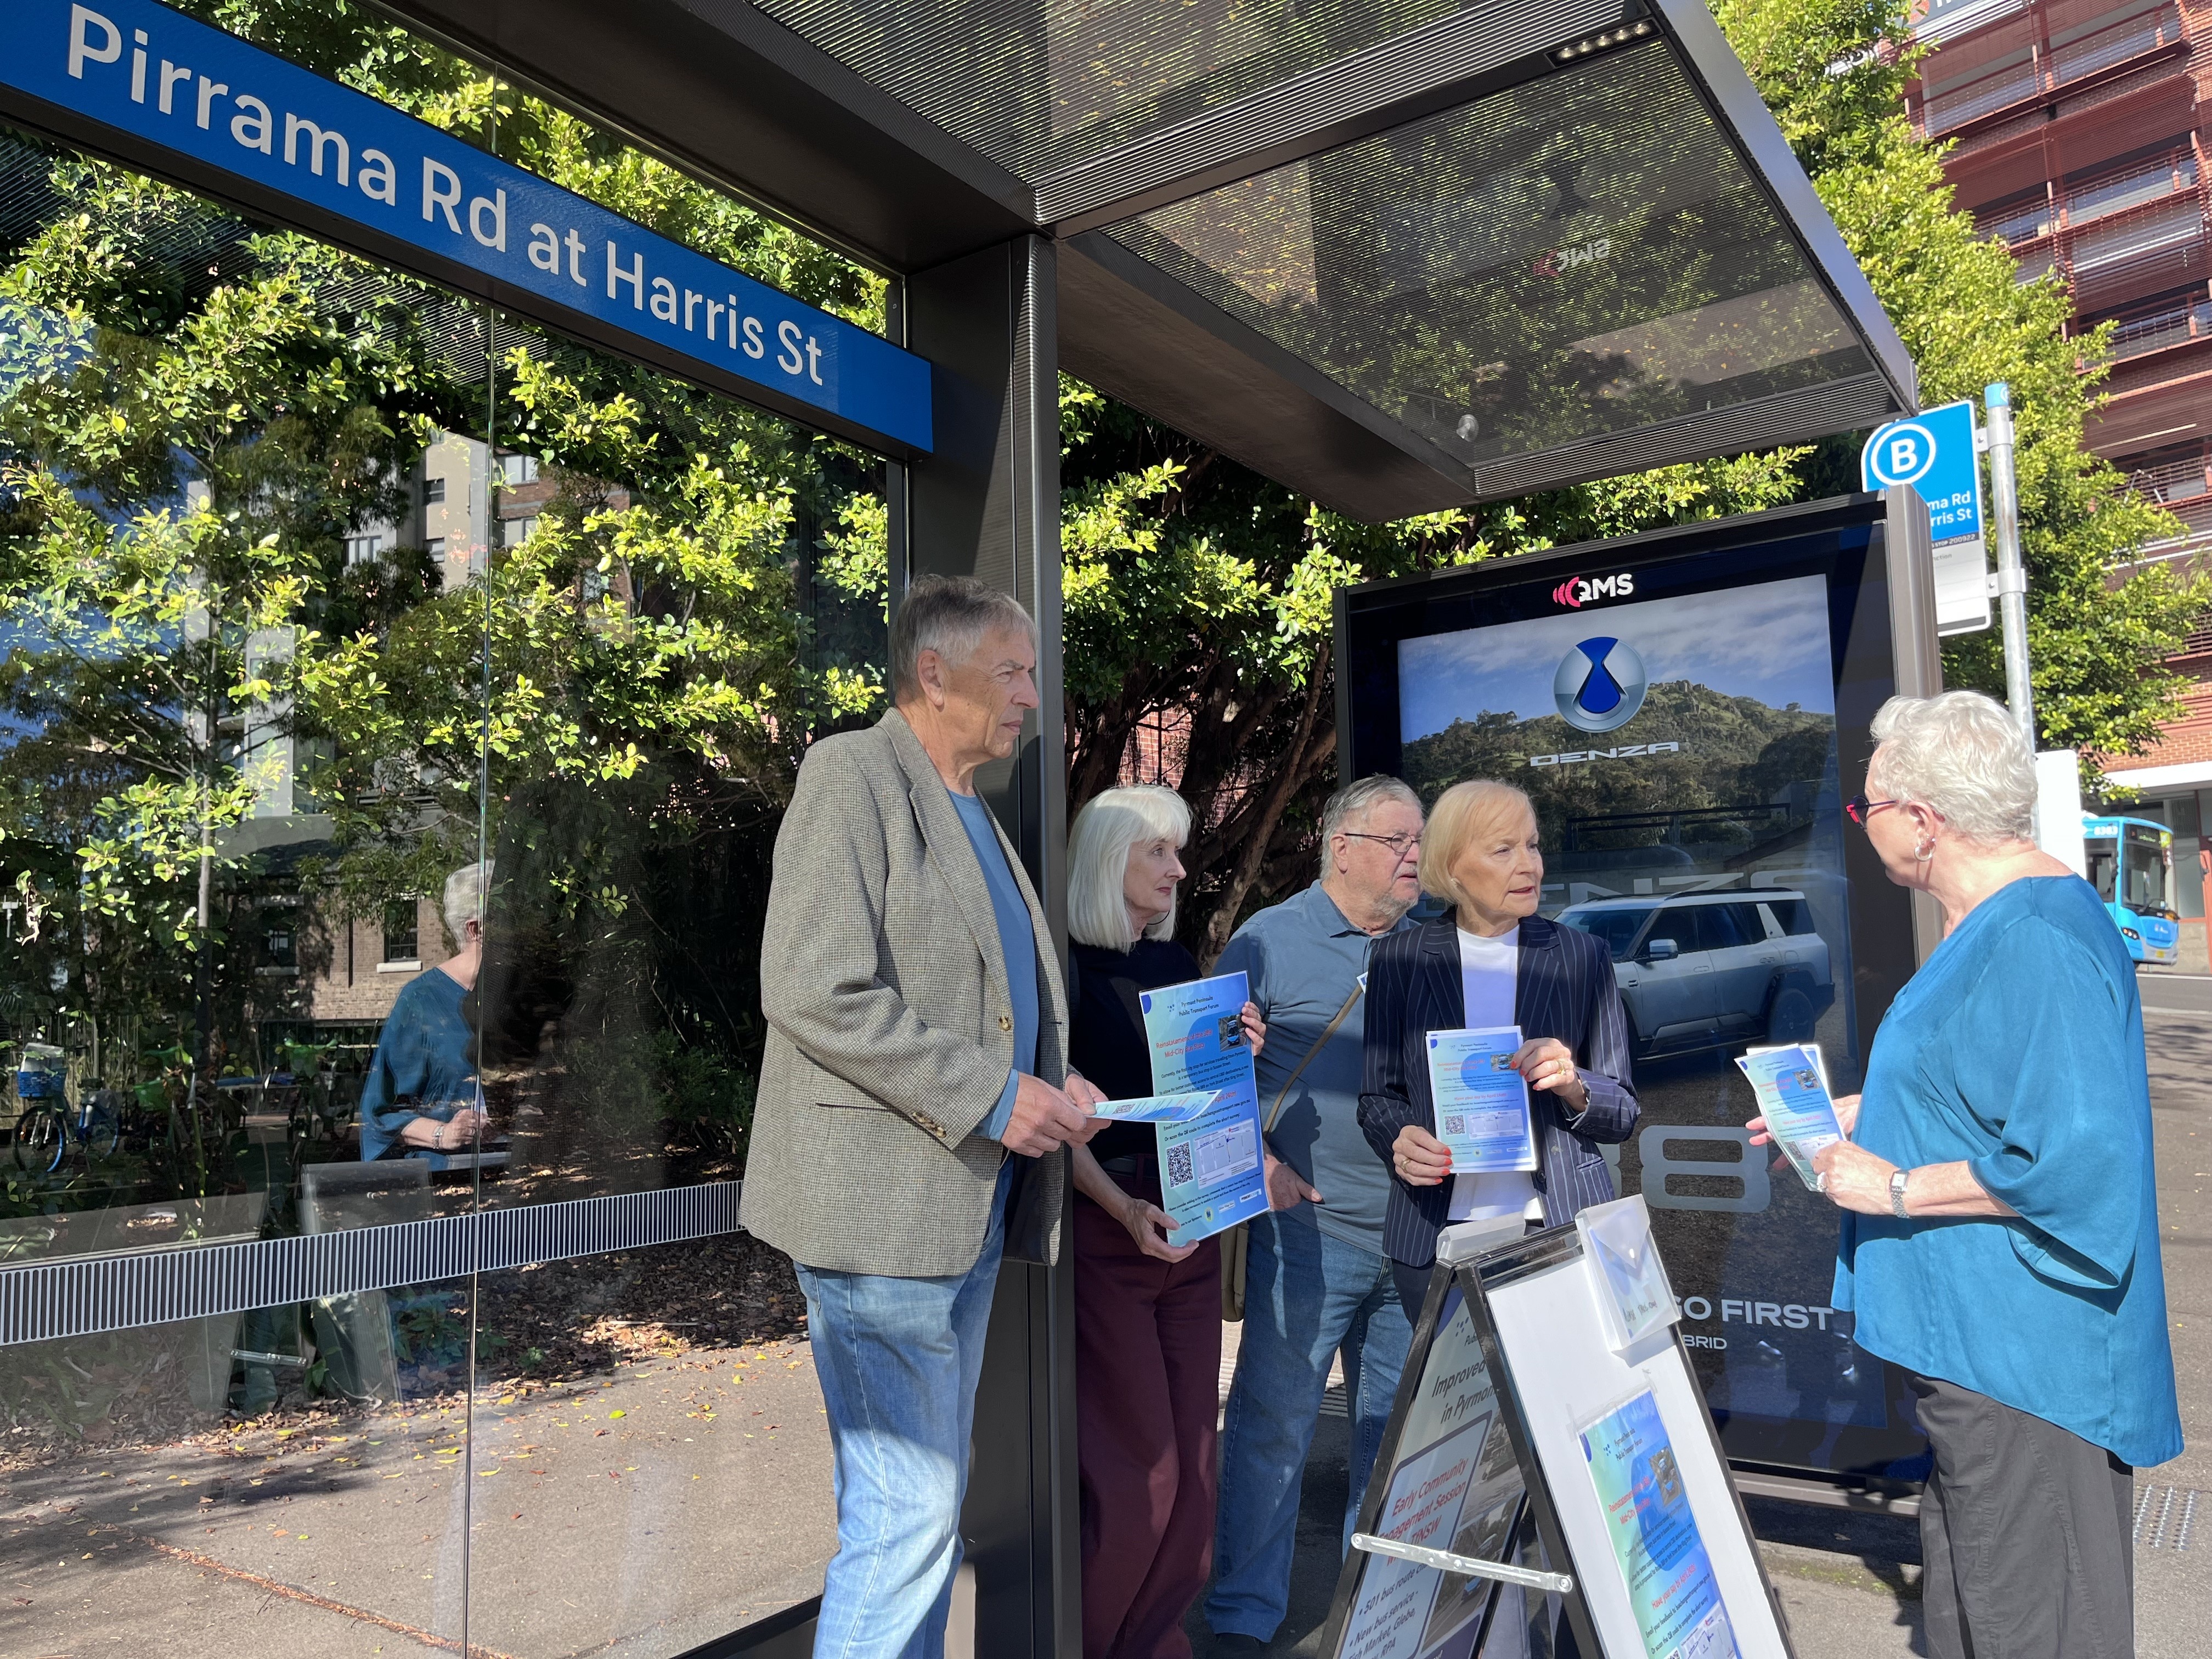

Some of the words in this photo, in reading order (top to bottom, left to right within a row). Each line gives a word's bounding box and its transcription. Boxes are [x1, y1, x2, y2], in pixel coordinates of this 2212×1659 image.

[67, 3, 396, 207] Pirrama
[422, 156, 506, 253] Rd
[528, 223, 586, 287] at
[606, 240, 765, 359] Harris
[777, 320, 823, 387] St
[1890, 438, 1917, 475] B
[1951, 490, 1971, 506] Rd
[1956, 508, 1972, 521] St
[1949, 534, 1976, 544] 200922
[1562, 573, 1634, 607] QMS
[1530, 741, 1679, 767] DENZA
[1721, 1299, 1834, 1331] FIRST
[1441, 1402, 1453, 1424] in
[1392, 1489, 1418, 1517] Early
[1418, 1458, 1469, 1499] Community
[1434, 1481, 1466, 1511] Session
[1364, 1592, 1380, 1615] 501
[1380, 1584, 1395, 1602] bus
[1395, 1568, 1415, 1590] route
[1355, 1624, 1373, 1646] New
[1374, 1612, 1389, 1630] bus
[1388, 1592, 1415, 1618] service
[1380, 1637, 1396, 1658] RPA
